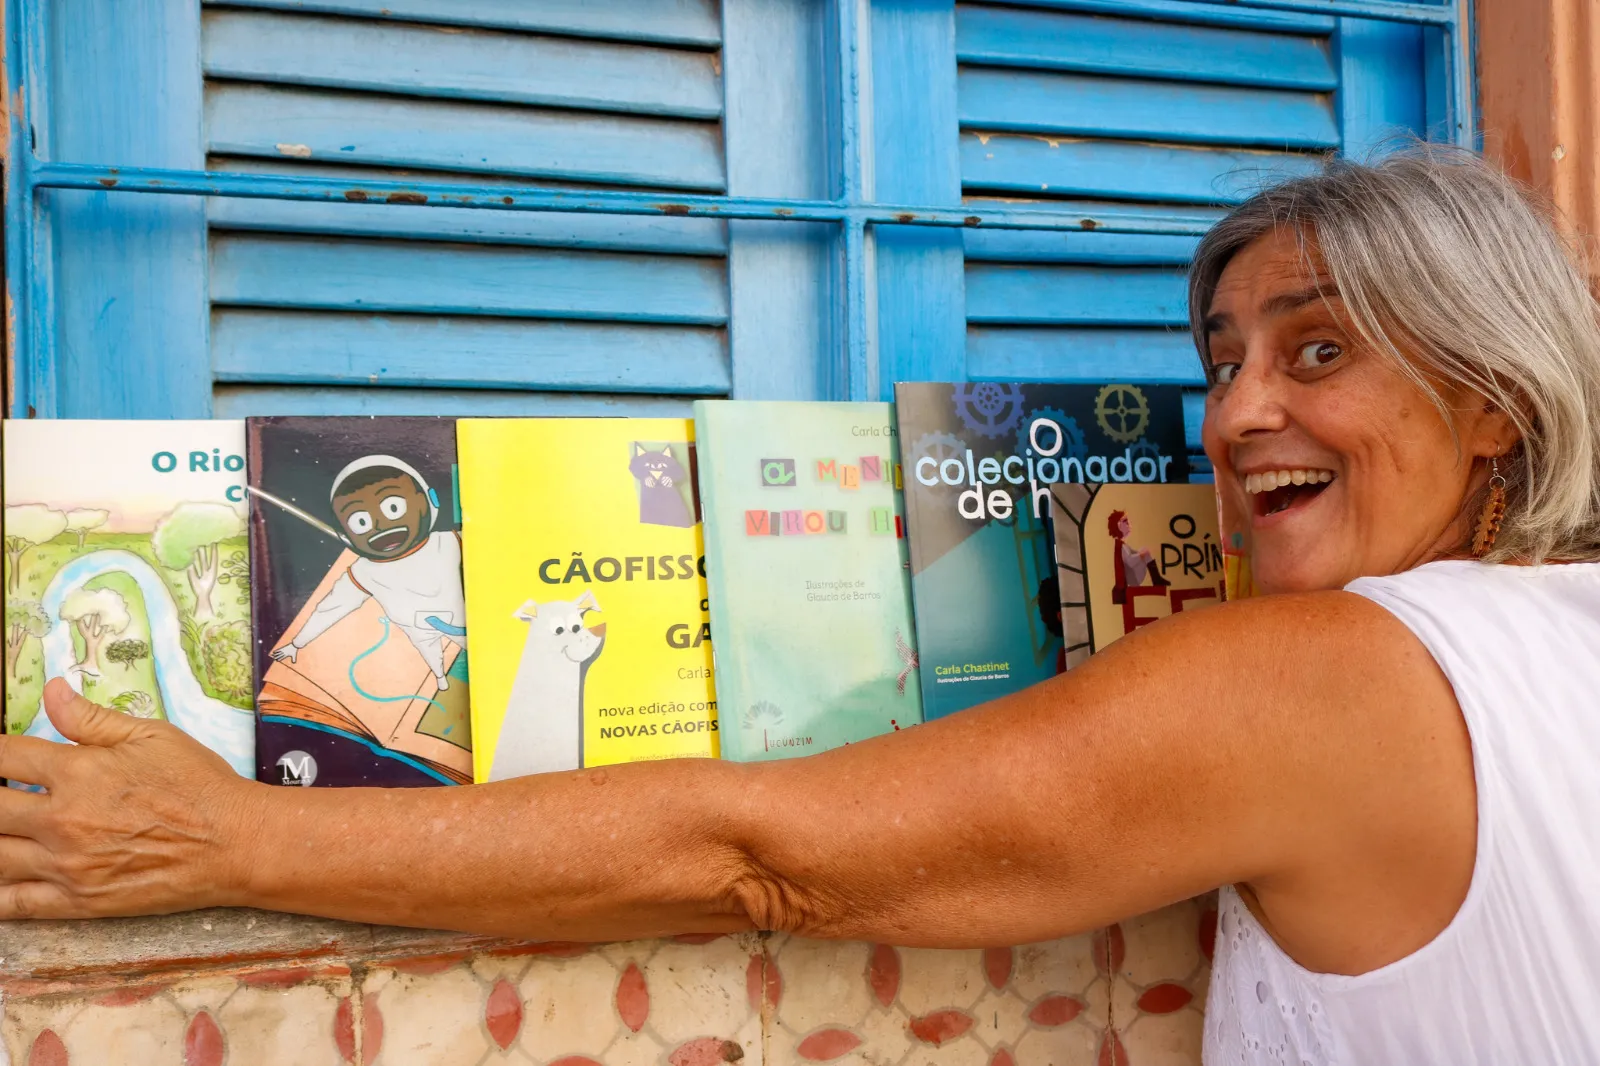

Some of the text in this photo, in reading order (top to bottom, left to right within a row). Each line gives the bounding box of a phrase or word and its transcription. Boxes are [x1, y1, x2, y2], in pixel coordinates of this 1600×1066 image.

[851, 425, 880, 437] Carla
[1030, 418, 1063, 457] O
[151, 448, 245, 473] O Rio
[915, 448, 1173, 487] colecionador
[816, 456, 903, 490] MENI
[225, 485, 249, 502] c
[957, 481, 1013, 520] de
[747, 511, 846, 535] VIROU
[1169, 514, 1196, 539] O
[841, 592, 852, 600] de
[853, 591, 881, 600] Barros
[855, 580, 865, 588] de
[665, 623, 712, 649] GA
[677, 667, 711, 680] Carla
[935, 661, 1010, 675] Carla Chastinet
[599, 701, 718, 718] nova edição com
[600, 724, 658, 739] NOVAS
[281, 756, 312, 780] M
